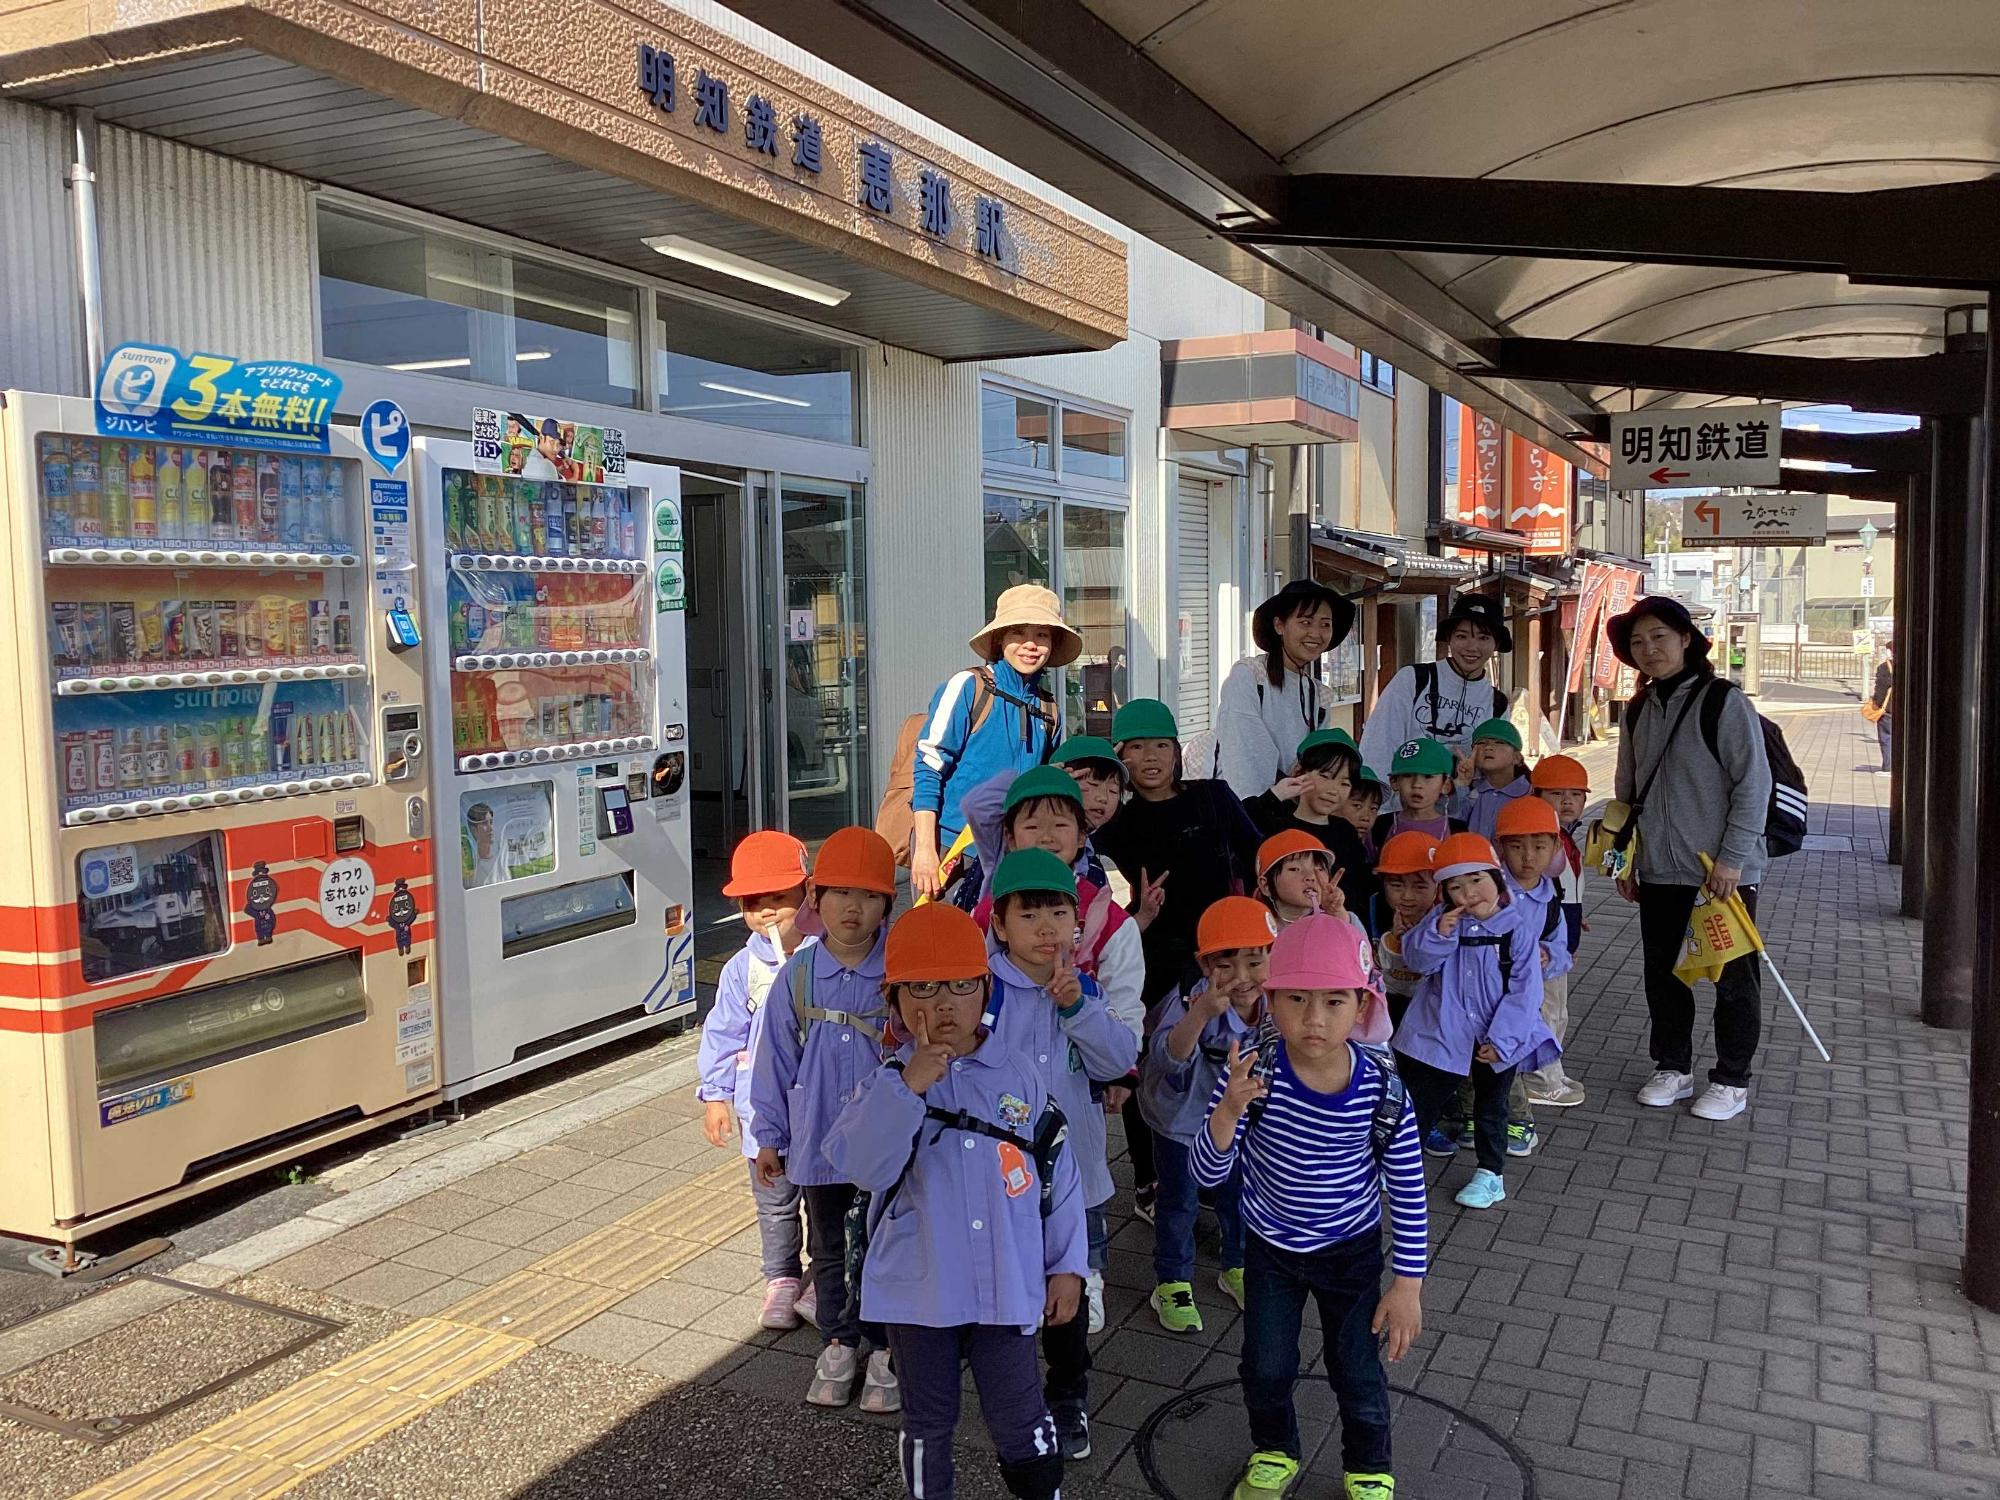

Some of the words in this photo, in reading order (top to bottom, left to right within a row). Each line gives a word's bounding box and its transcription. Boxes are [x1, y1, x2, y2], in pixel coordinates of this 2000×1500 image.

[638, 44, 823, 174] 明知鉄道
[858, 142, 1004, 261] 恵那駅
[120, 351, 171, 366] SUNTORY
[121, 370, 153, 401] ピ
[244, 365, 333, 388] アプリダウンロード
[260, 378, 309, 394] でどれでも
[474, 408, 496, 424] 結果に
[105, 416, 158, 435] ジハンピ
[371, 409, 403, 458] ピ
[474, 425, 499, 441] こだわる
[474, 441, 498, 459] オトコ
[1621, 420, 1770, 465] 明知鉄道
[605, 458, 625, 473] トクホ
[383, 495, 407, 505] ジハンピ
[1741, 499, 1799, 521] えなてらす
[330, 867, 362, 883] おつり
[324, 884, 369, 902] 忘れない
[335, 903, 361, 918] でね!
[1713, 913, 1735, 950] HELLO
